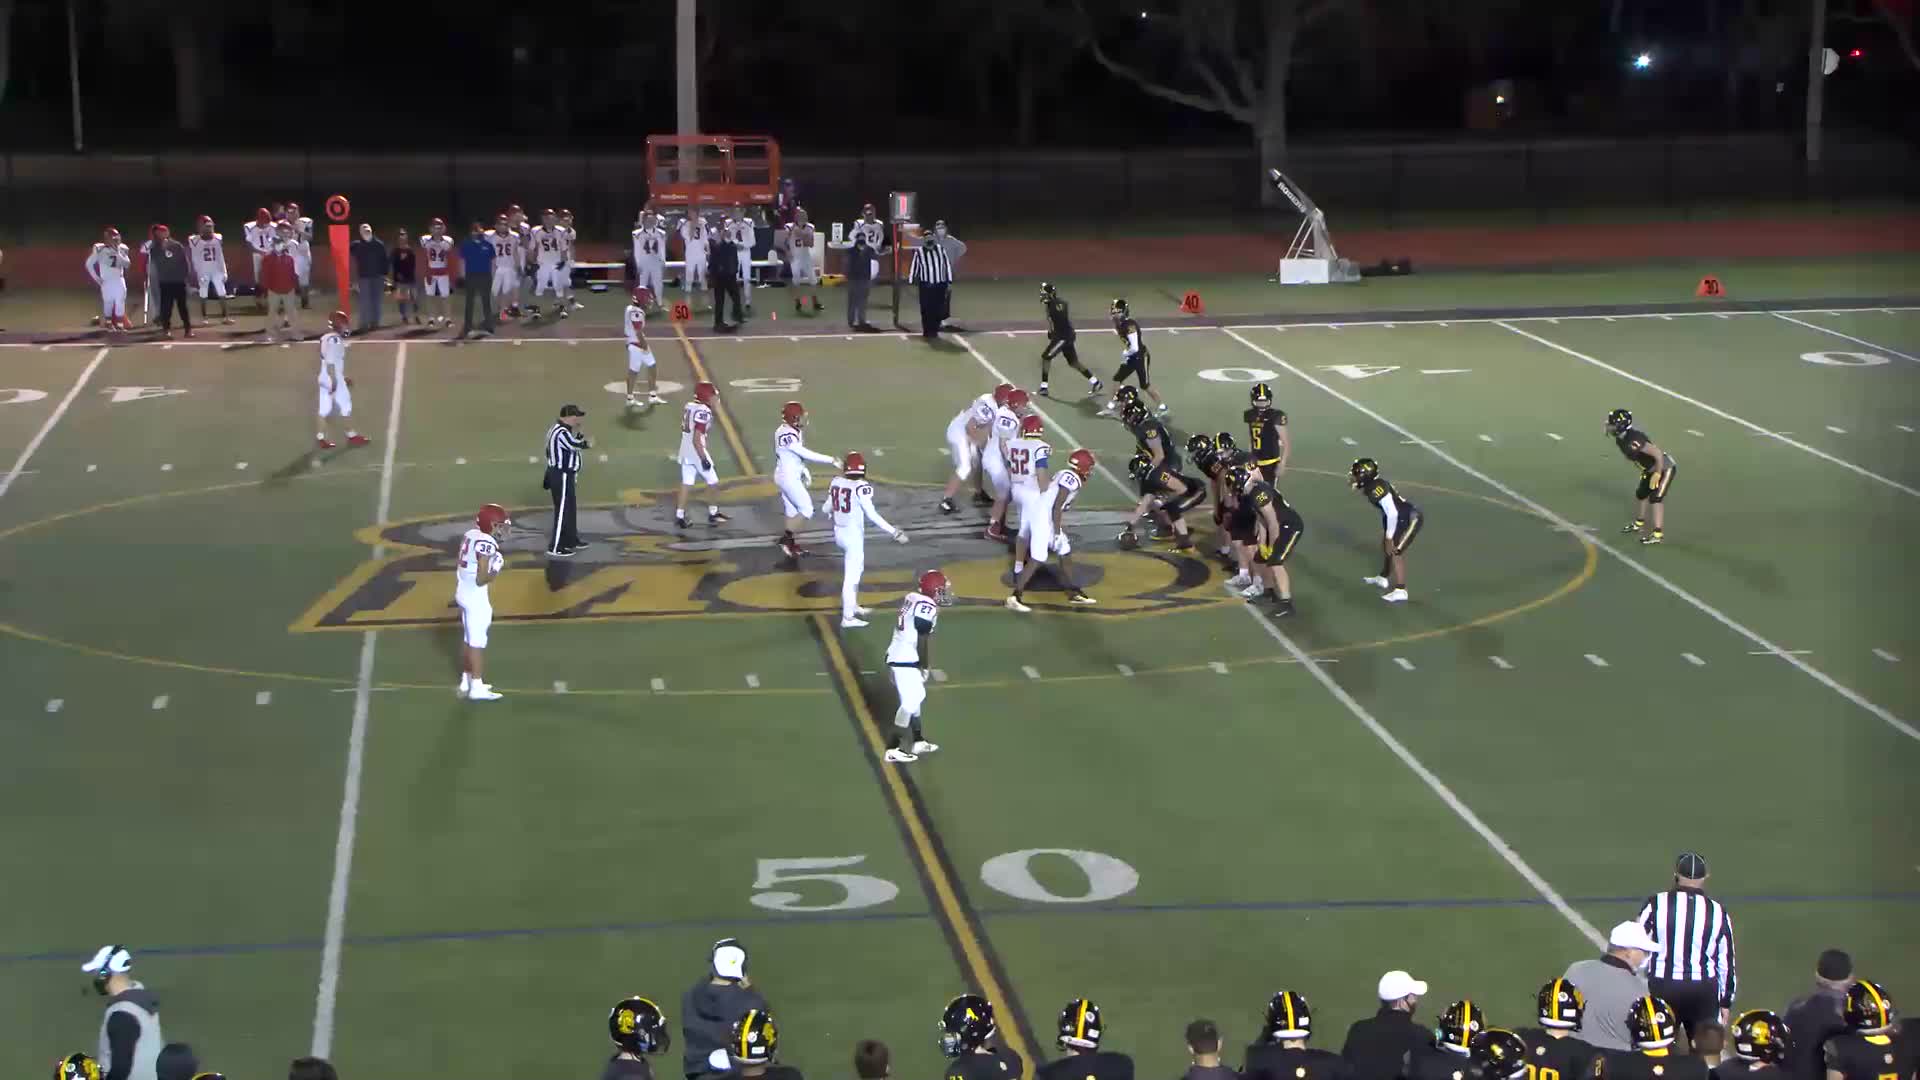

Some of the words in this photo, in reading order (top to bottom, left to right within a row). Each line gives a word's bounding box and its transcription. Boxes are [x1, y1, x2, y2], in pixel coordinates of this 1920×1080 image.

[202, 248, 216, 262] 21
[1184, 295, 1200, 310] 40
[674, 305, 689, 320] 50
[1251, 427, 1262, 450] 5
[1010, 447, 1030, 475] 52
[831, 486, 852, 513] 83
[920, 604, 933, 615] 27
